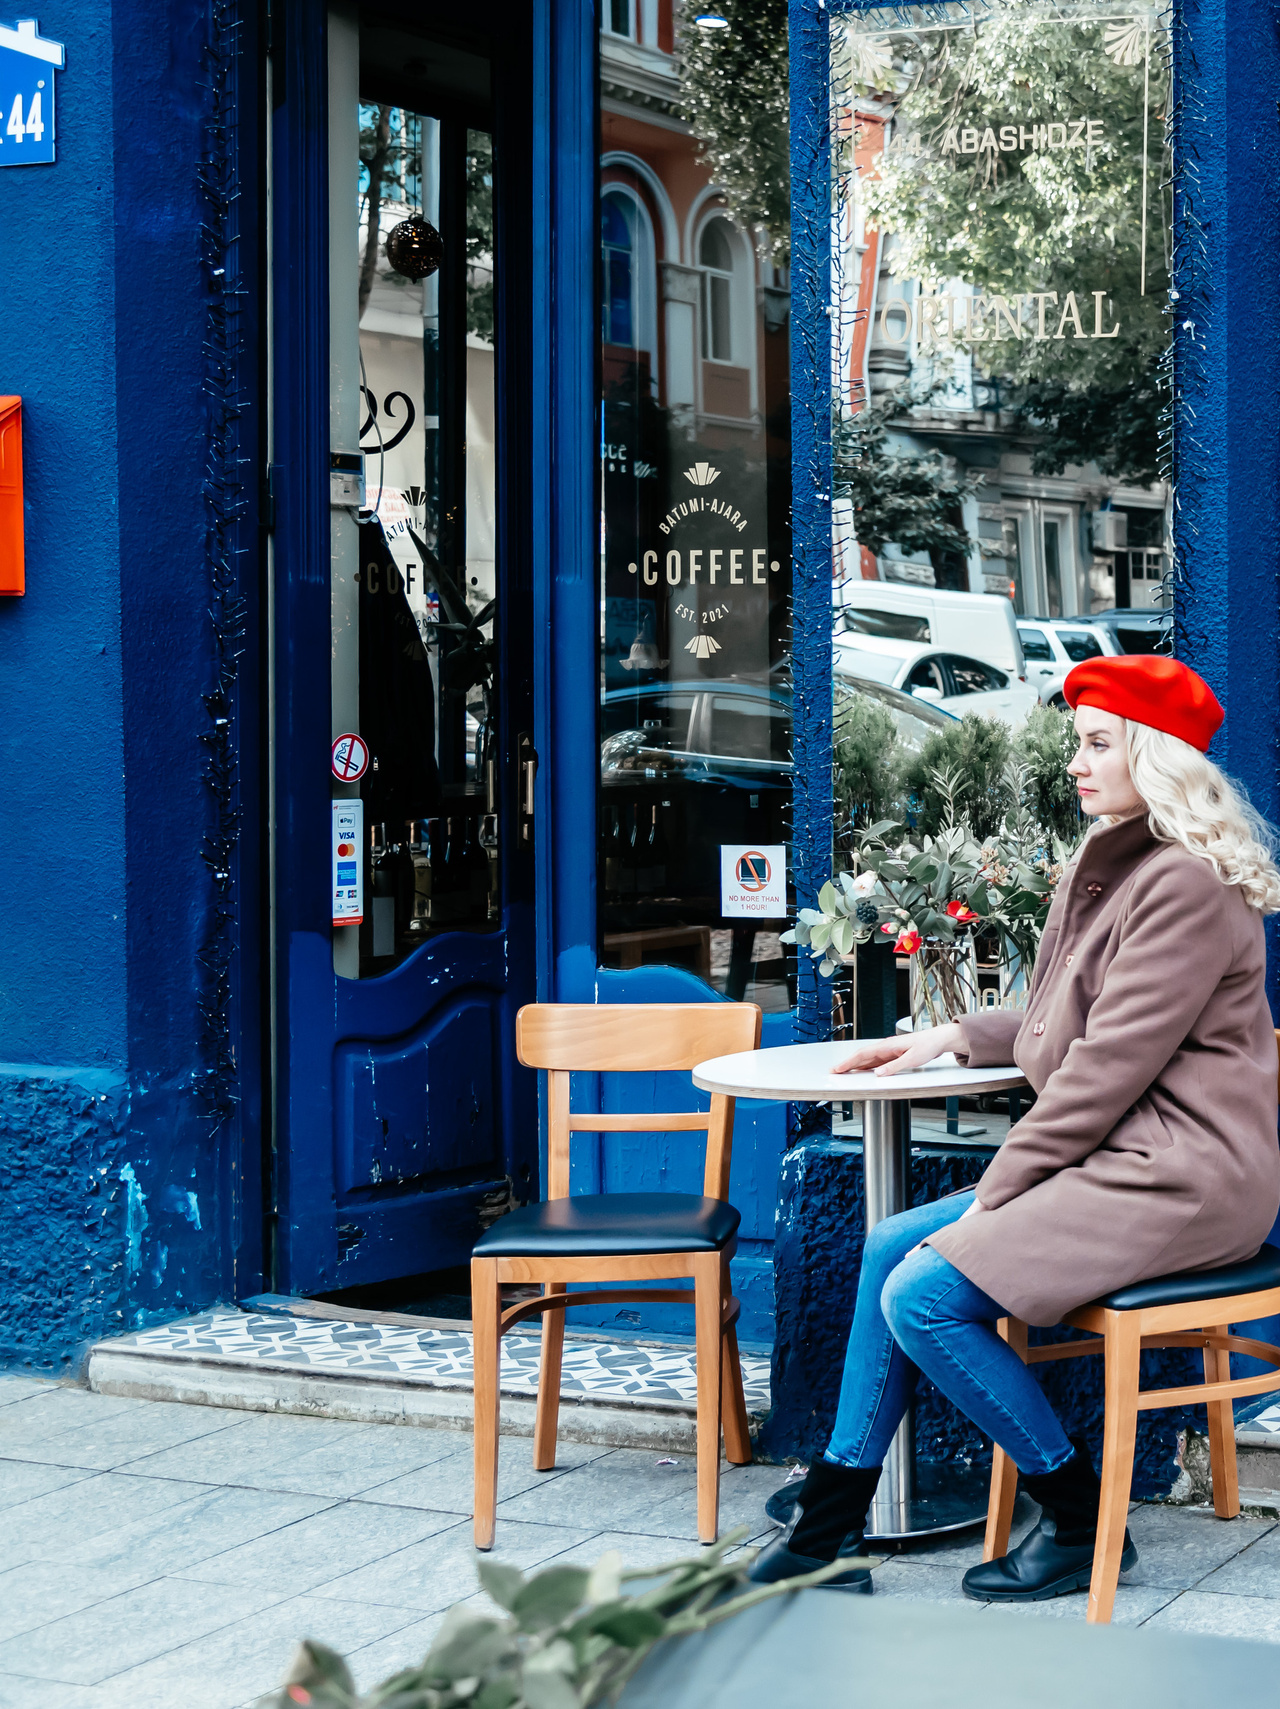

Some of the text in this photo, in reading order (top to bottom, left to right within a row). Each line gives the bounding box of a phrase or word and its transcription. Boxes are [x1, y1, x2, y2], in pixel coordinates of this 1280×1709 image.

[941, 119, 1104, 155] ABASHIDZE
[879, 290, 1121, 344] ORIENTAL
[658, 497, 748, 535] BATUMI-AJARA
[643, 548, 767, 586] COFFEE
[674, 603, 697, 623] EST.
[702, 603, 730, 624] 2021
[338, 831, 355, 840] VISA
[746, 903, 768, 911] HOUR!
[761, 895, 780, 903] THAN
